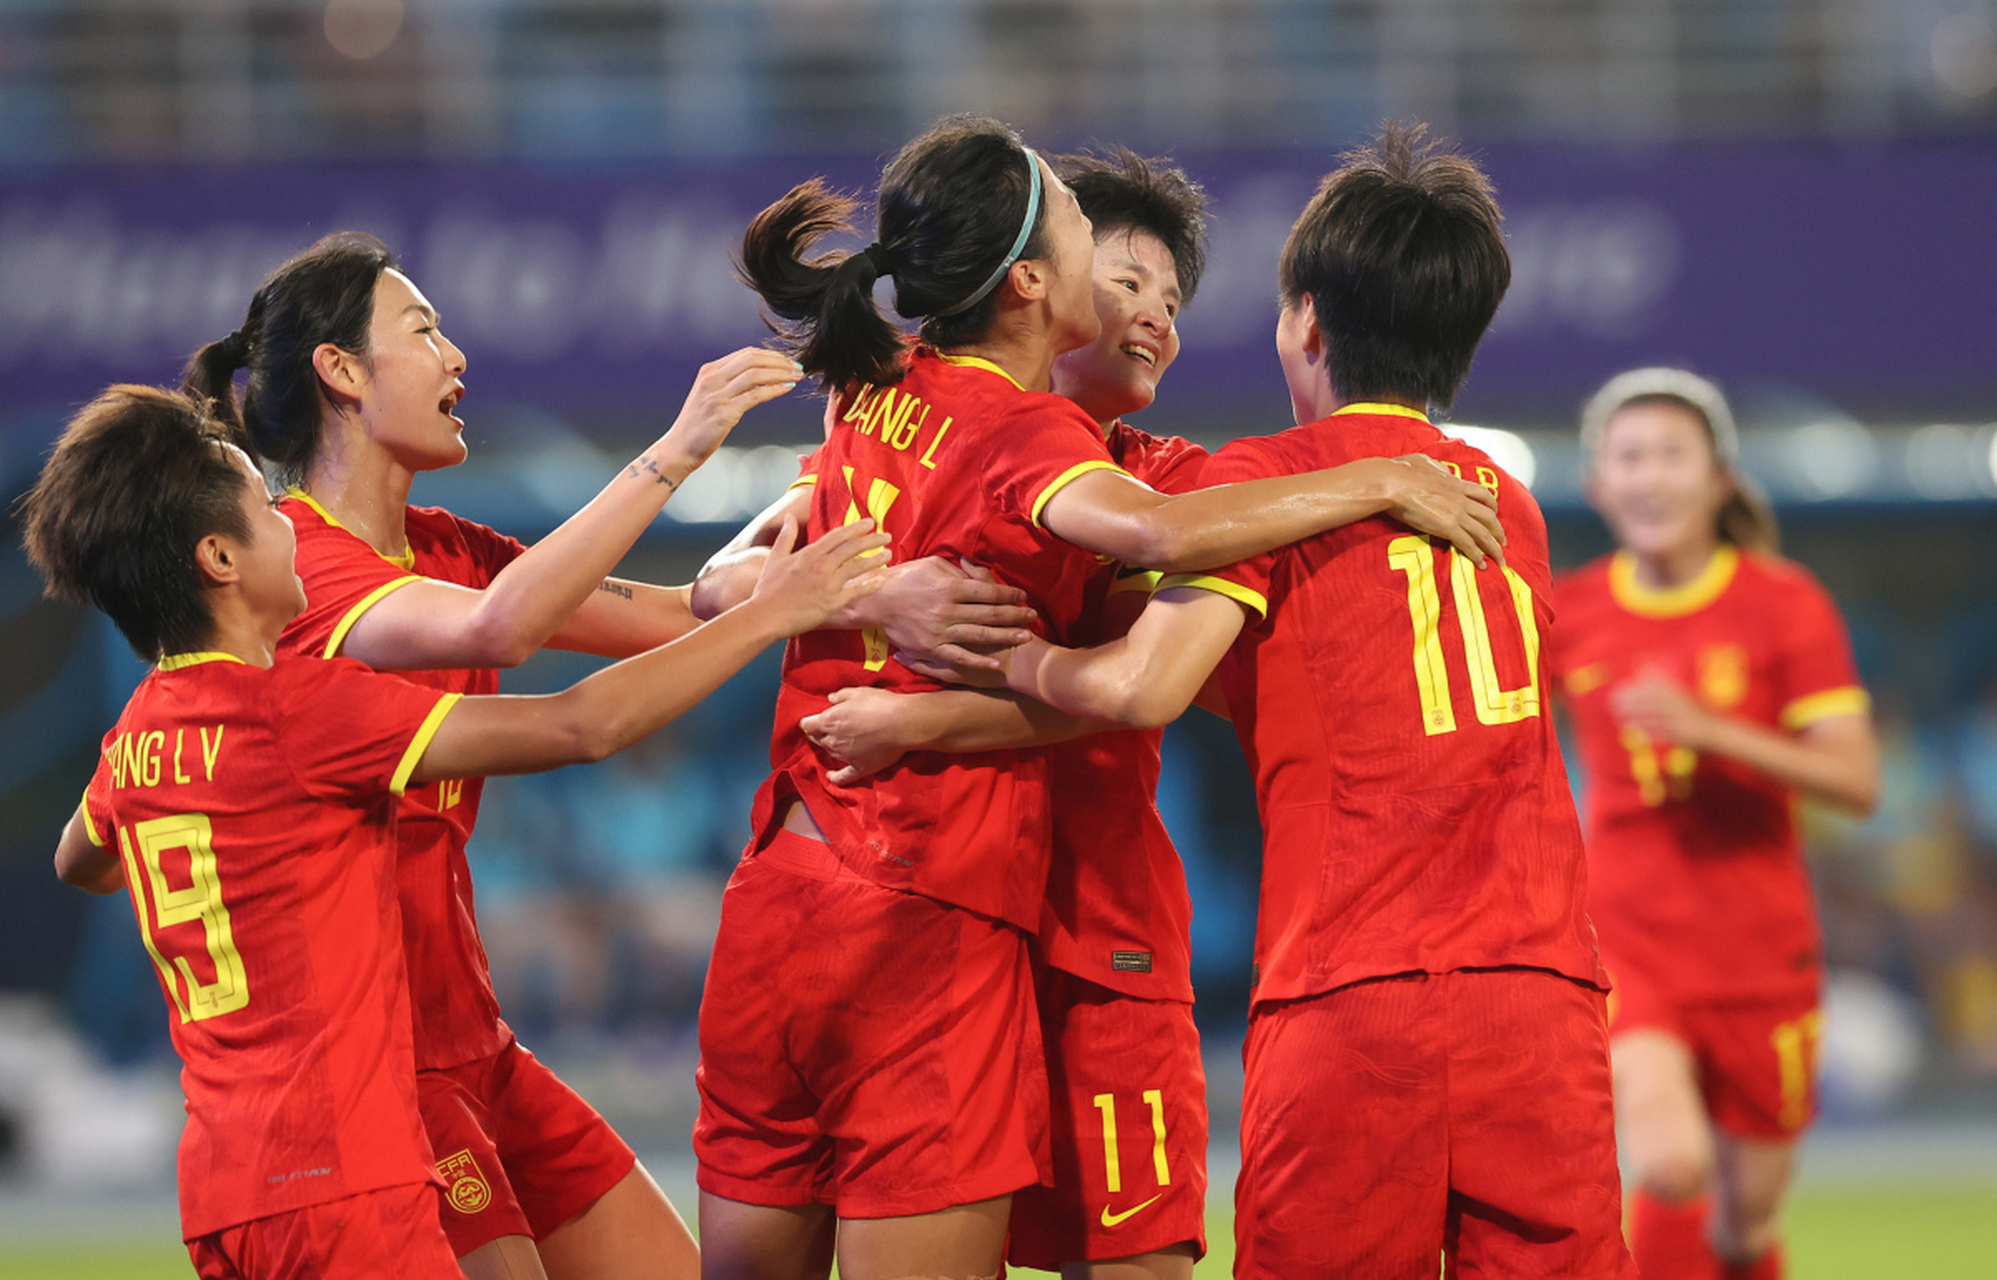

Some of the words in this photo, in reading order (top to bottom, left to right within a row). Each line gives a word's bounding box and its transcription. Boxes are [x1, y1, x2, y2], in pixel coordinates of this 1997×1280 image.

[1387, 534, 1540, 737] 10
[120, 812, 250, 1025] 19
[1093, 1089, 1171, 1193] 11
